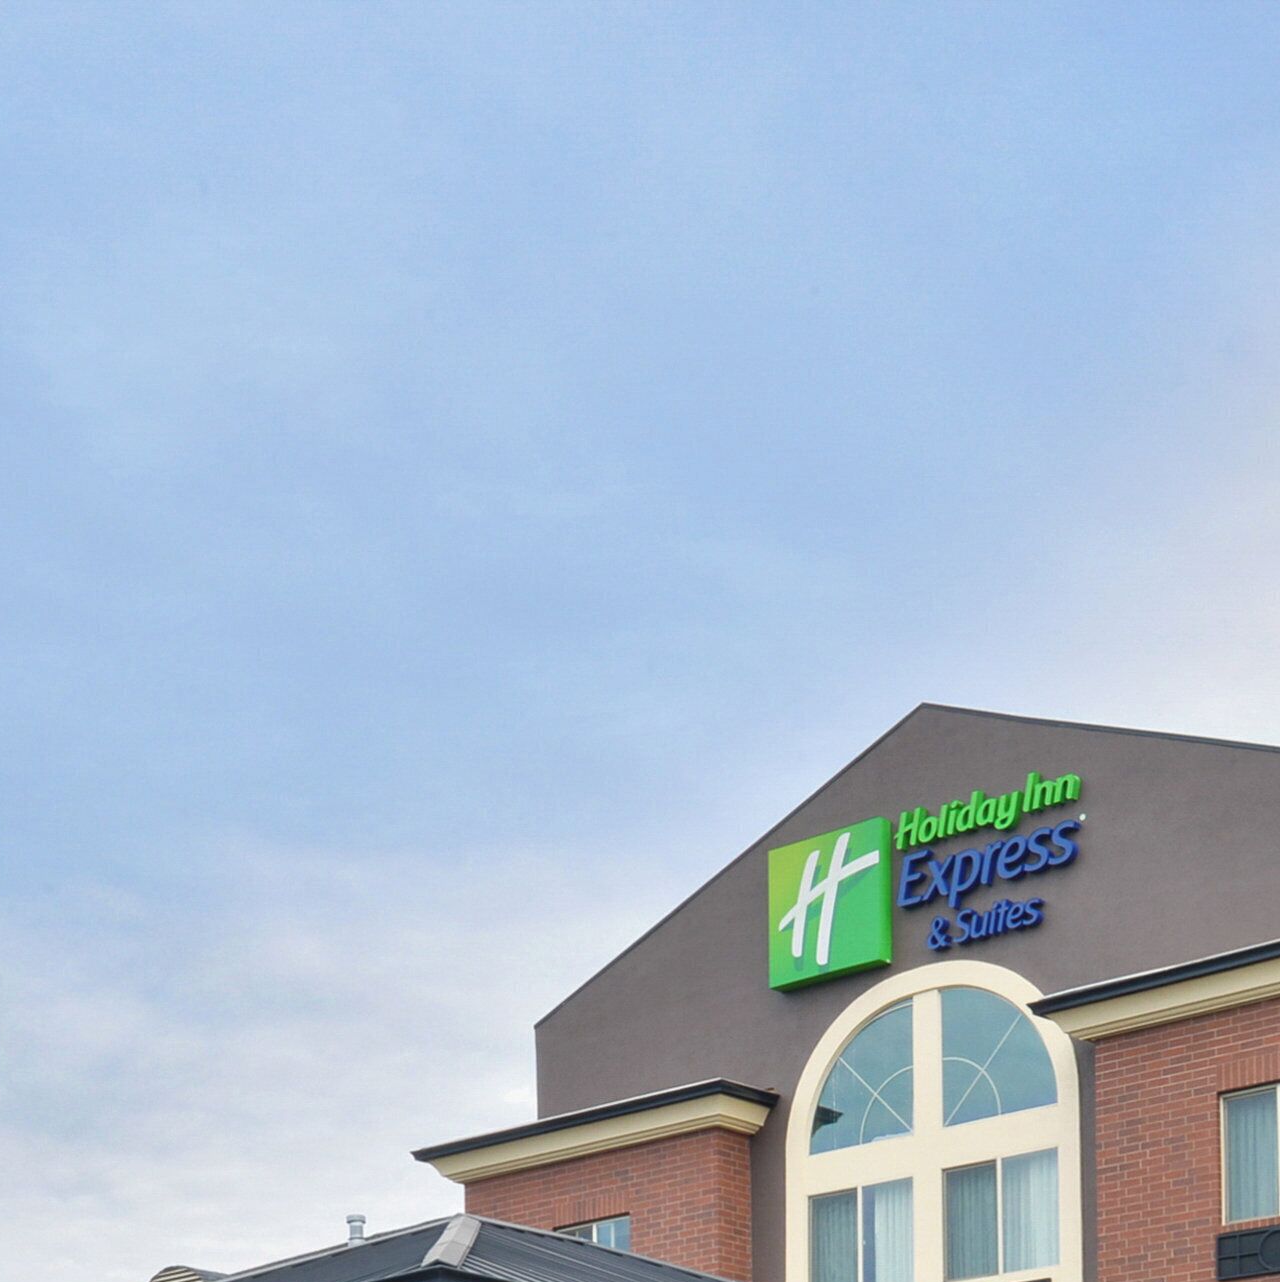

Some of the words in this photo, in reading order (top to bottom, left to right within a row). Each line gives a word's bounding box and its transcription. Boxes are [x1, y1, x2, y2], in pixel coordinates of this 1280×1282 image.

[894, 791, 1023, 850] Holiday
[1022, 771, 1082, 813] Inn
[778, 831, 880, 966] H
[896, 820, 1082, 909] Express
[927, 915, 953, 951] &
[953, 897, 1045, 945] Suites
